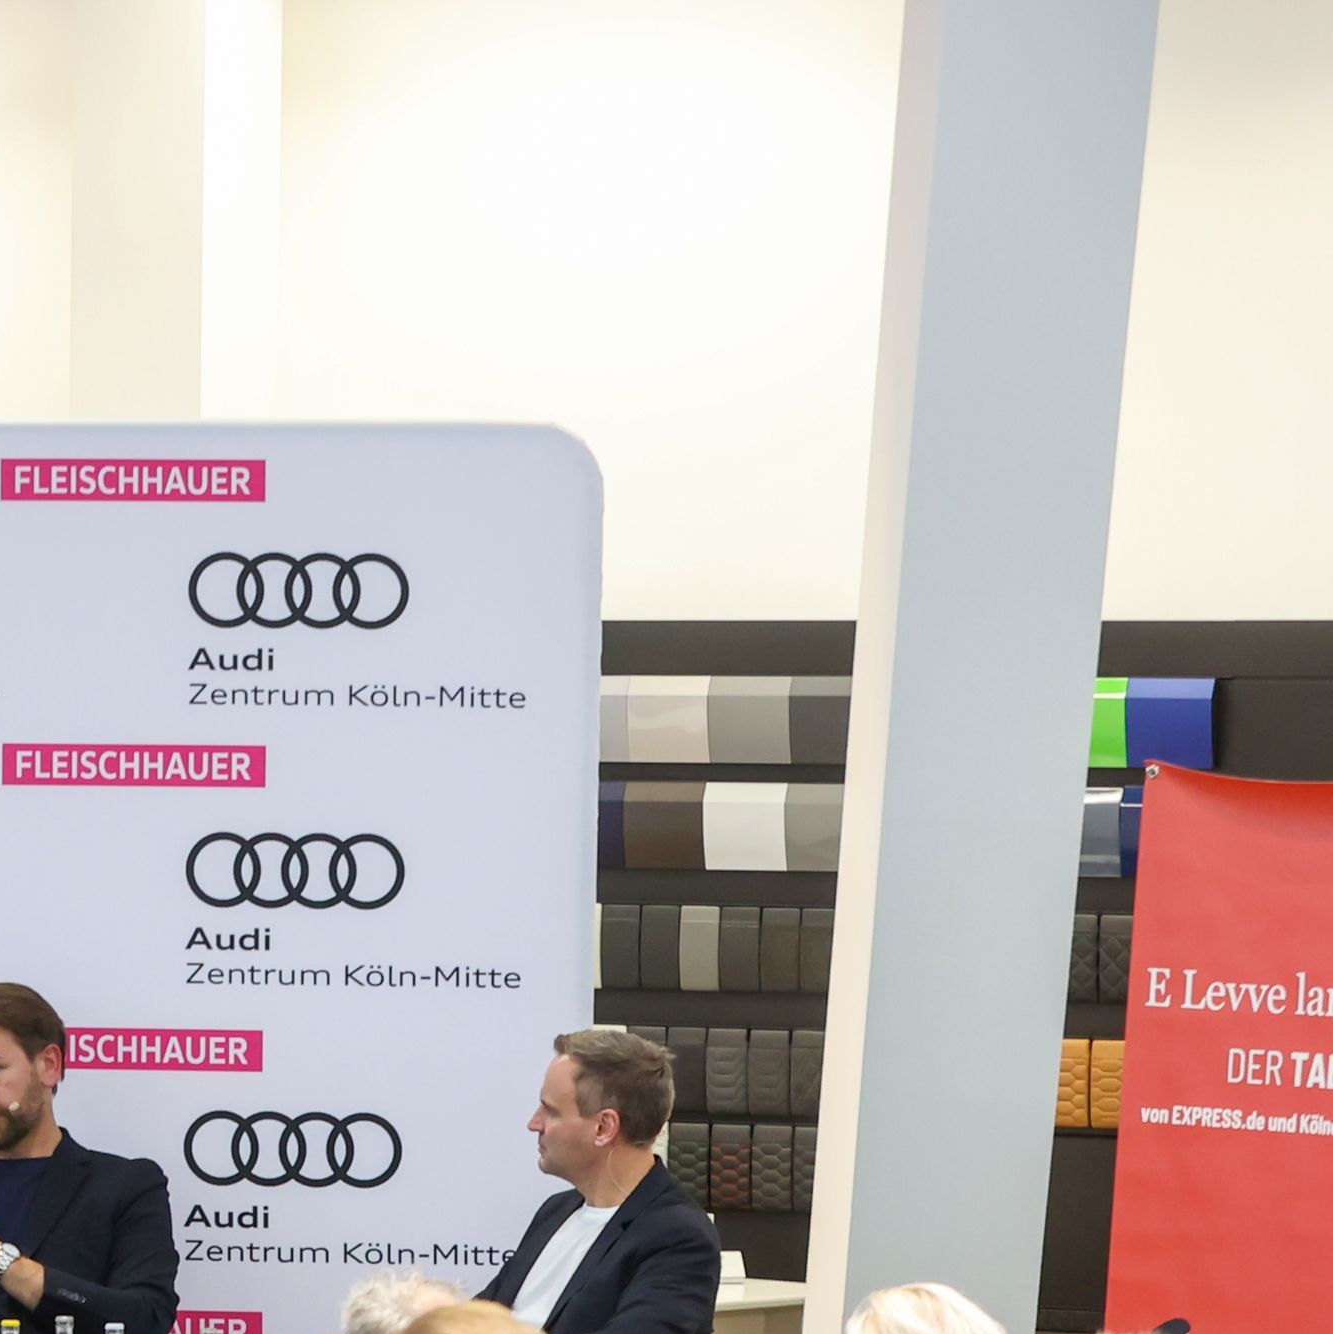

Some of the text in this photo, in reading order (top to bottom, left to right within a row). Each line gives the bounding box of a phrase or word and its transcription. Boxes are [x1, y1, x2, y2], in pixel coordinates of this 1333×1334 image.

[14, 465, 251, 496] FLEISCHHAUER
[188, 647, 274, 671] Audi
[189, 683, 526, 709] Zentrum Köln-Mitte
[16, 750, 252, 781] FLEISCHHAUER
[185, 927, 271, 951] Audi
[186, 962, 521, 989] Zentrum Köln-Mitte
[1145, 967, 1171, 1007] E
[1181, 968, 1287, 1015] Levve
[69, 1034, 249, 1065] ISCHHAUER
[1227, 1047, 1283, 1086] DER
[1141, 1105, 1333, 1136] von EXPRESS.de und Köln
[183, 1204, 269, 1229] Audi
[184, 1239, 330, 1264] Zentrum
